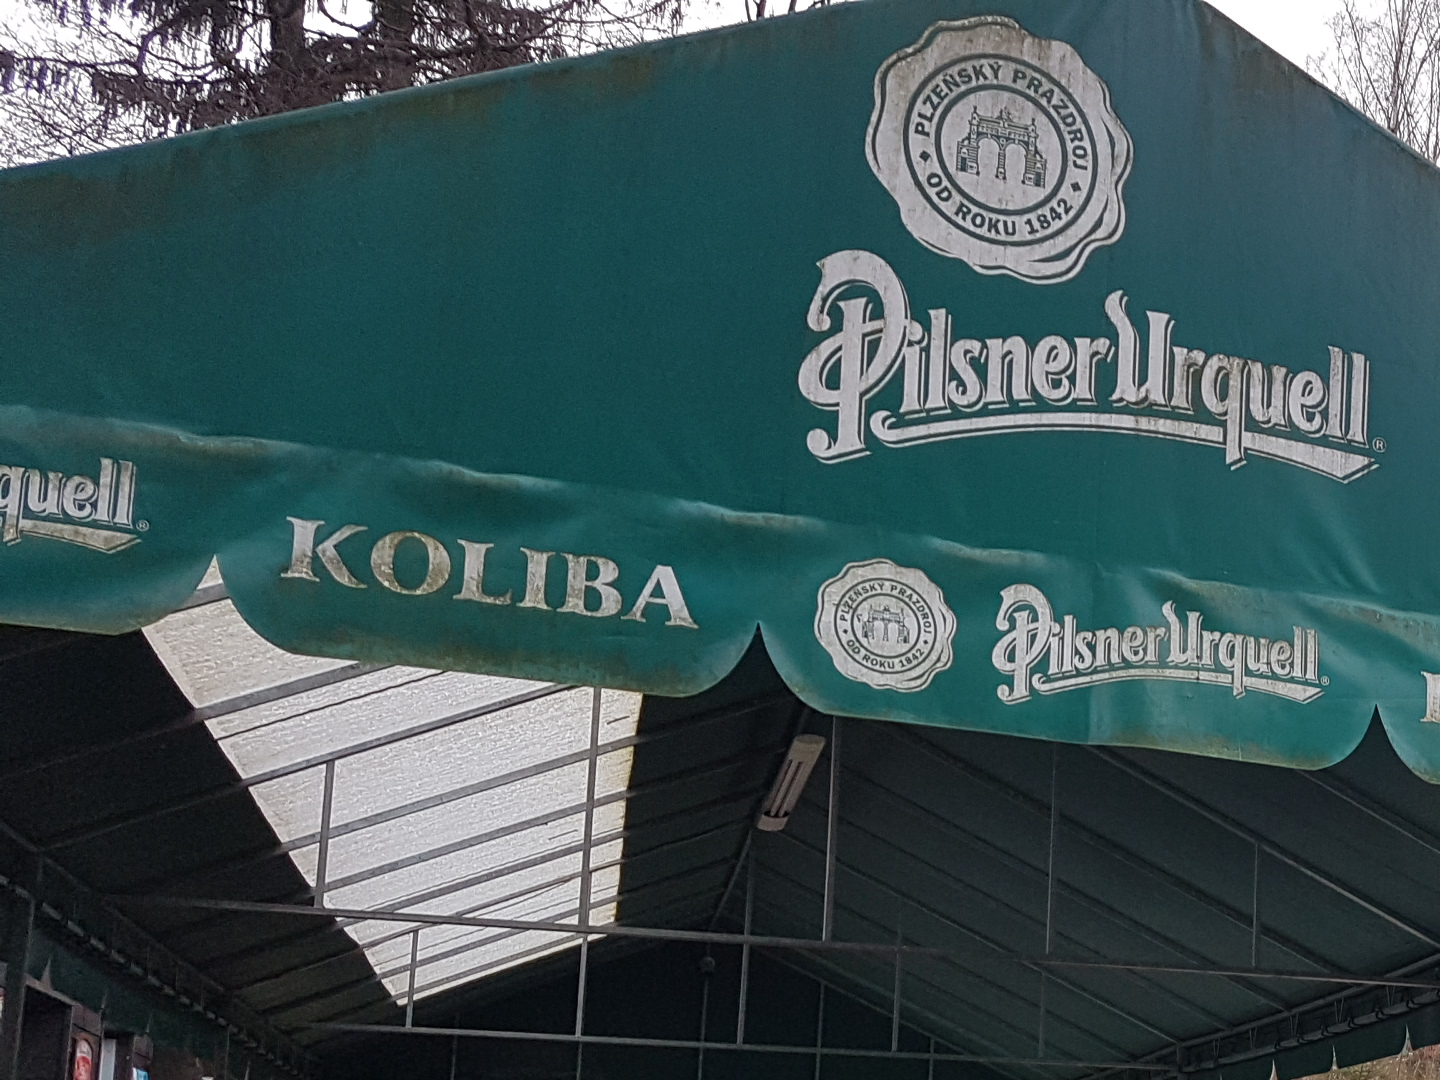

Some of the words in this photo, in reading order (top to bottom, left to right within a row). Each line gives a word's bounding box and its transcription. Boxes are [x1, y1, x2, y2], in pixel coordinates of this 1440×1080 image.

[1012, 69, 1088, 171] PRAZDROJ
[926, 172, 950, 202] OD
[954, 203, 1016, 236] ROKU
[1025, 198, 1073, 236] 1842
[798, 249, 1115, 464] Pilsner
[1106, 290, 1370, 470] Urquell
[280, 516, 699, 629] KOLIBA
[890, 585, 932, 634] PRAZDROJ
[846, 639, 860, 655] OD
[862, 655, 895, 669] ROKU
[899, 648, 925, 668] 1842
[991, 583, 1167, 705] Pilsner
[1162, 600, 1319, 699] Urquell
